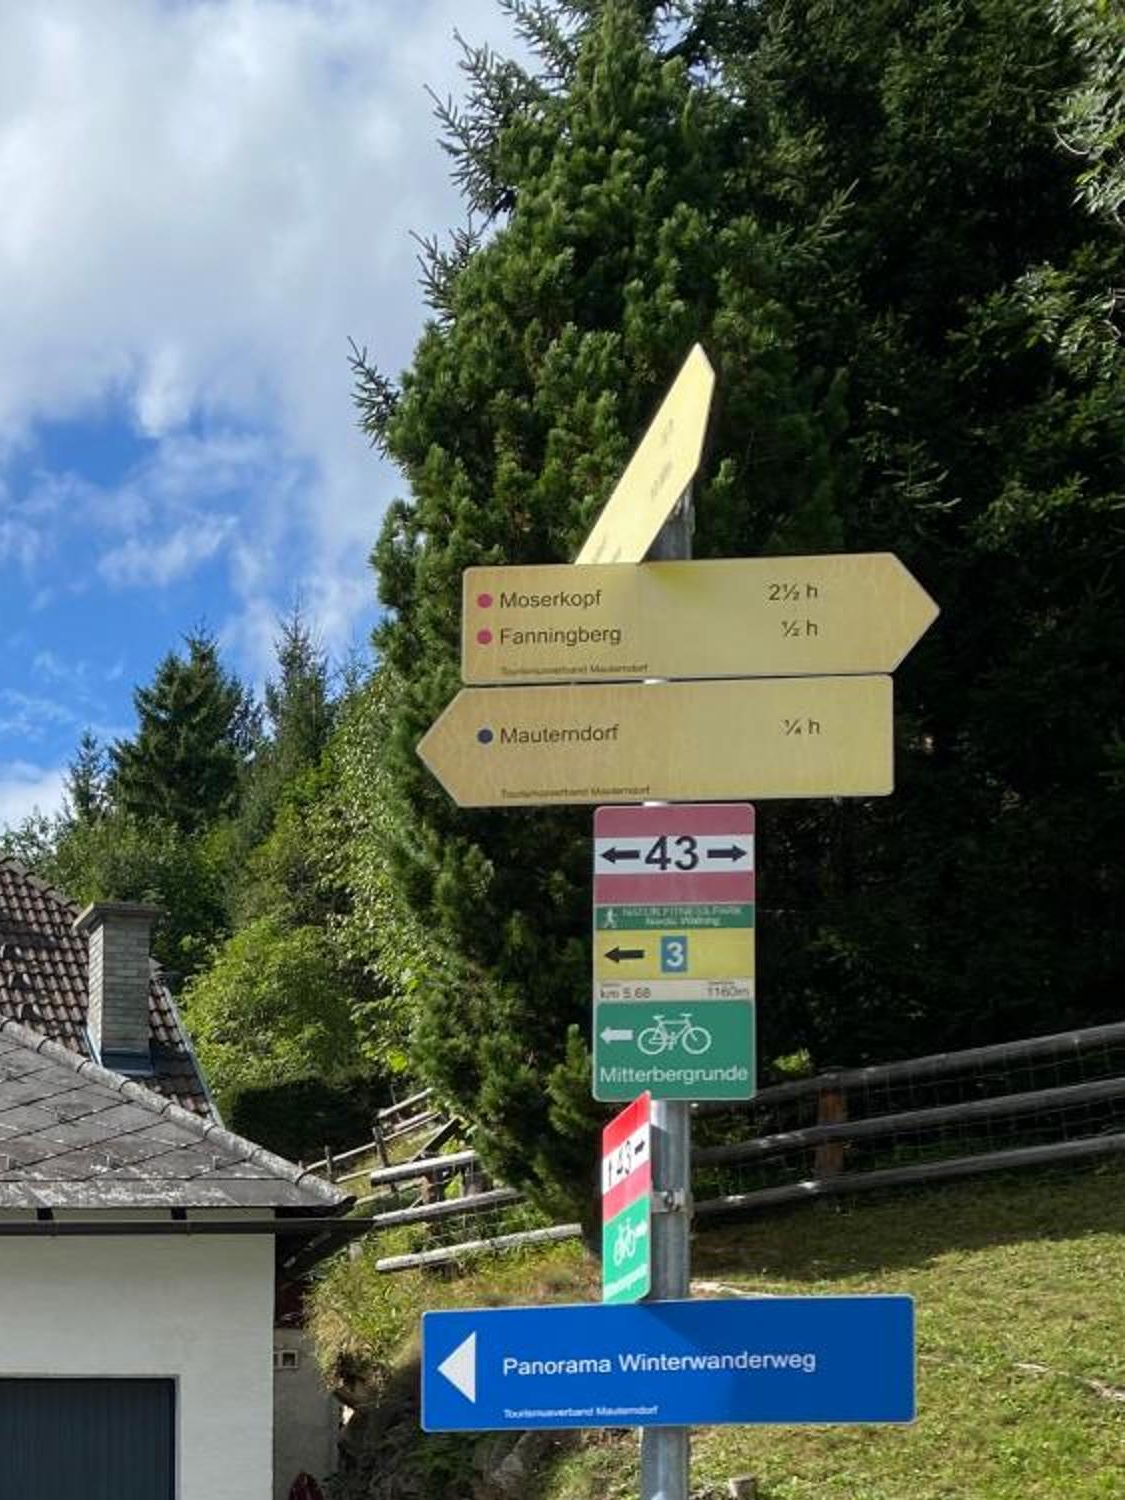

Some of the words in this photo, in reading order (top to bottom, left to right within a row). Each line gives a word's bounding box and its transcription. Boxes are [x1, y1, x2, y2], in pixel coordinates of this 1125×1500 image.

[499, 590, 602, 610] Moserkopf
[805, 583, 818, 599] h
[499, 626, 622, 647] Fanningberg
[805, 619, 818, 637] h
[499, 723, 620, 744] Mauterndorf
[808, 718, 820, 735] h
[643, 835, 700, 871] 43
[666, 941, 685, 968] 3
[599, 1064, 749, 1085] Mitterbergrunde
[502, 1357, 612, 1377] Panorama
[617, 1350, 817, 1374] Winterwanderweg
[595, 1404, 660, 1417] Mauterndorf
